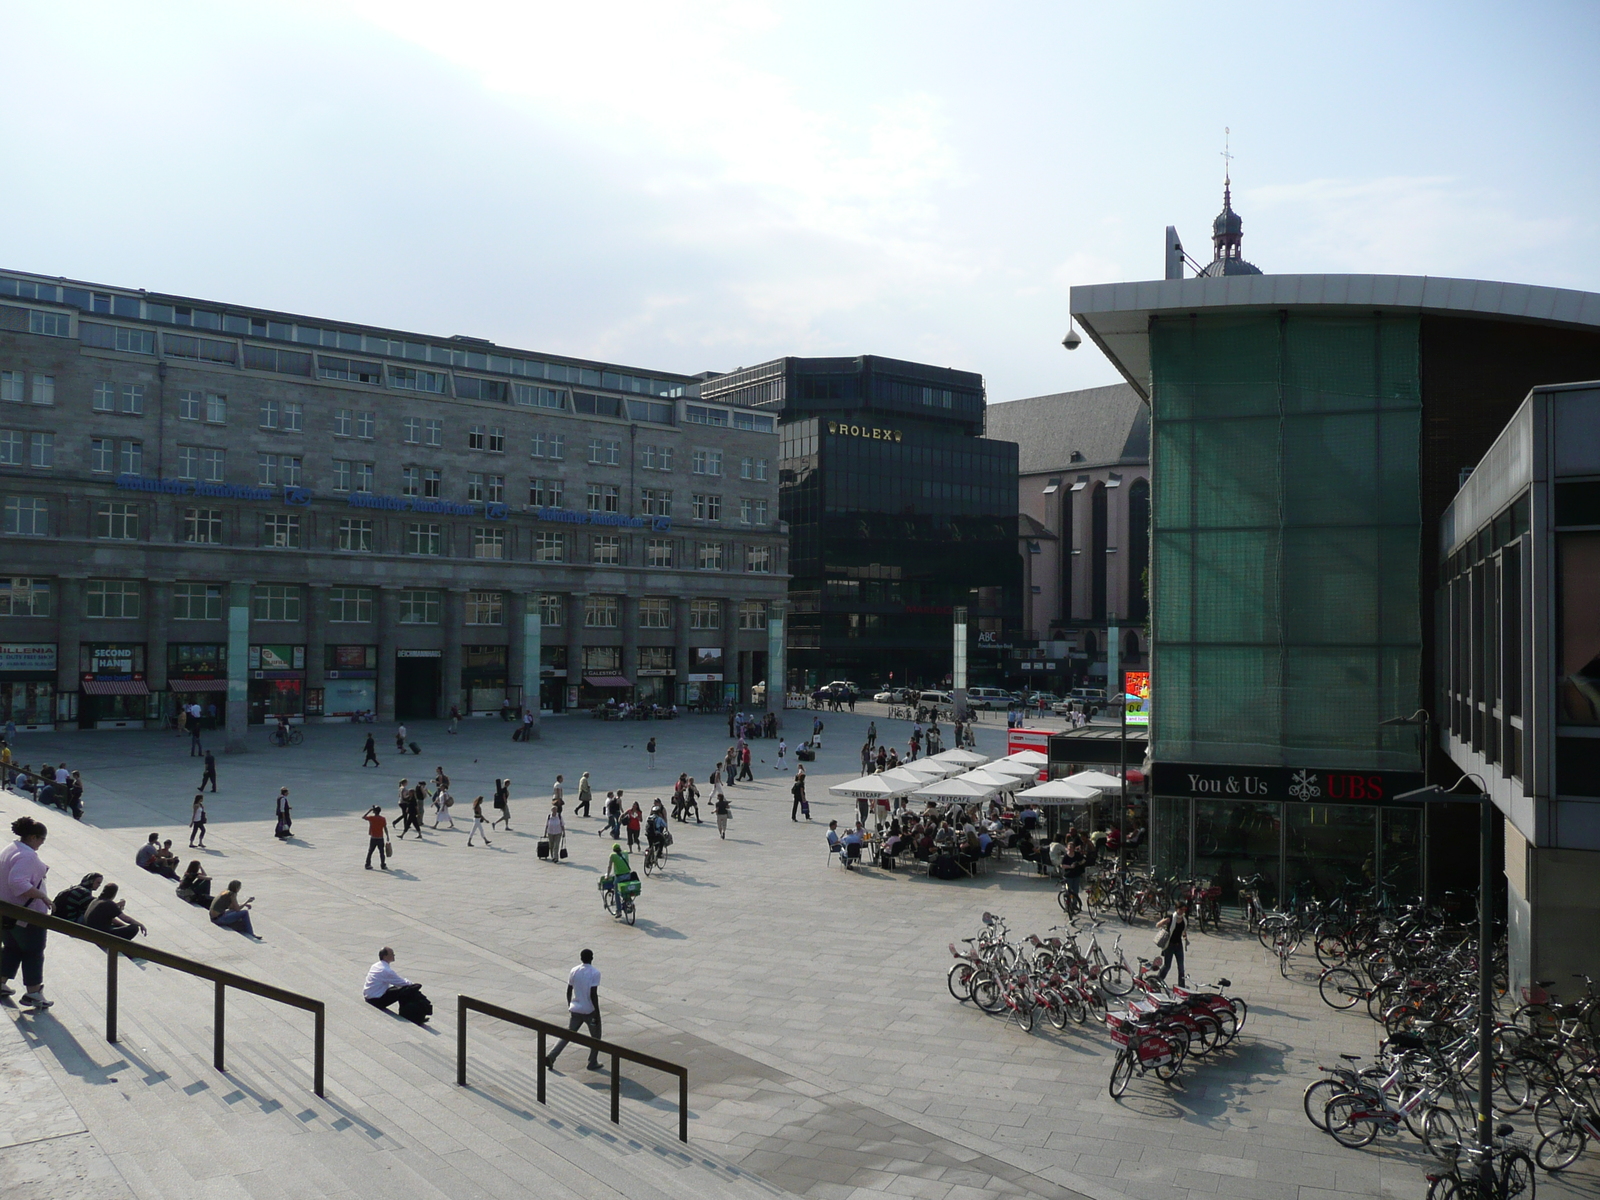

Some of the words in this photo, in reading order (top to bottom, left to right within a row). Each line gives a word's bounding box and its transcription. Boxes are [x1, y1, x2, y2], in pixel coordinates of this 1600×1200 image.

[839, 423, 892, 441] ROLEX
[978, 631, 996, 642] ABC
[94, 649, 132, 657] SECOND
[1187, 774, 1221, 793] You
[1225, 776, 1240, 794] &
[1243, 776, 1268, 795] Us
[1326, 773, 1384, 800] UBS
